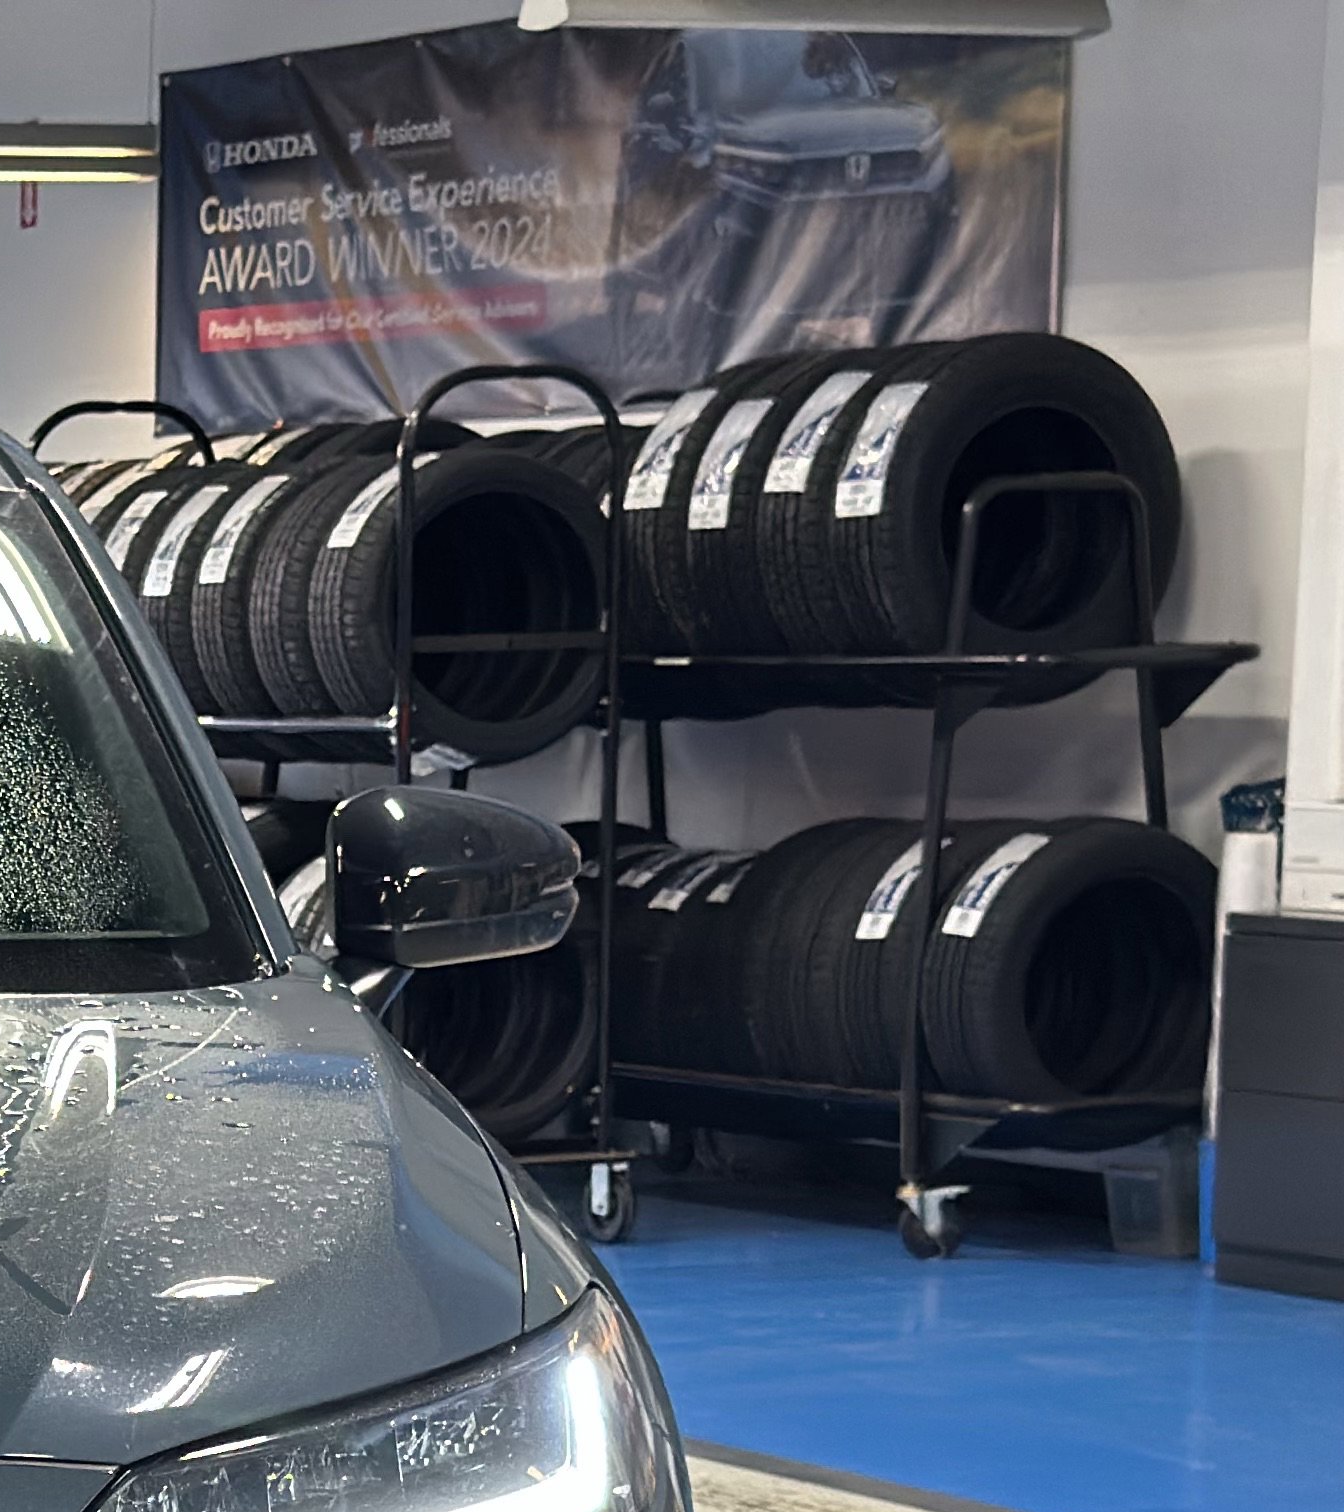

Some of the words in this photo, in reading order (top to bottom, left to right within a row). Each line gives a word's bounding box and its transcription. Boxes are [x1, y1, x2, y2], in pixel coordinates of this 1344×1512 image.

[223, 132, 318, 168] HONDA
[199, 195, 313, 235] Customer
[320, 179, 403, 222] Service
[408, 163, 561, 224] Experience
[198, 239, 316, 295] AWARD
[328, 224, 462, 283] WINNER
[470, 212, 554, 270] 2024
